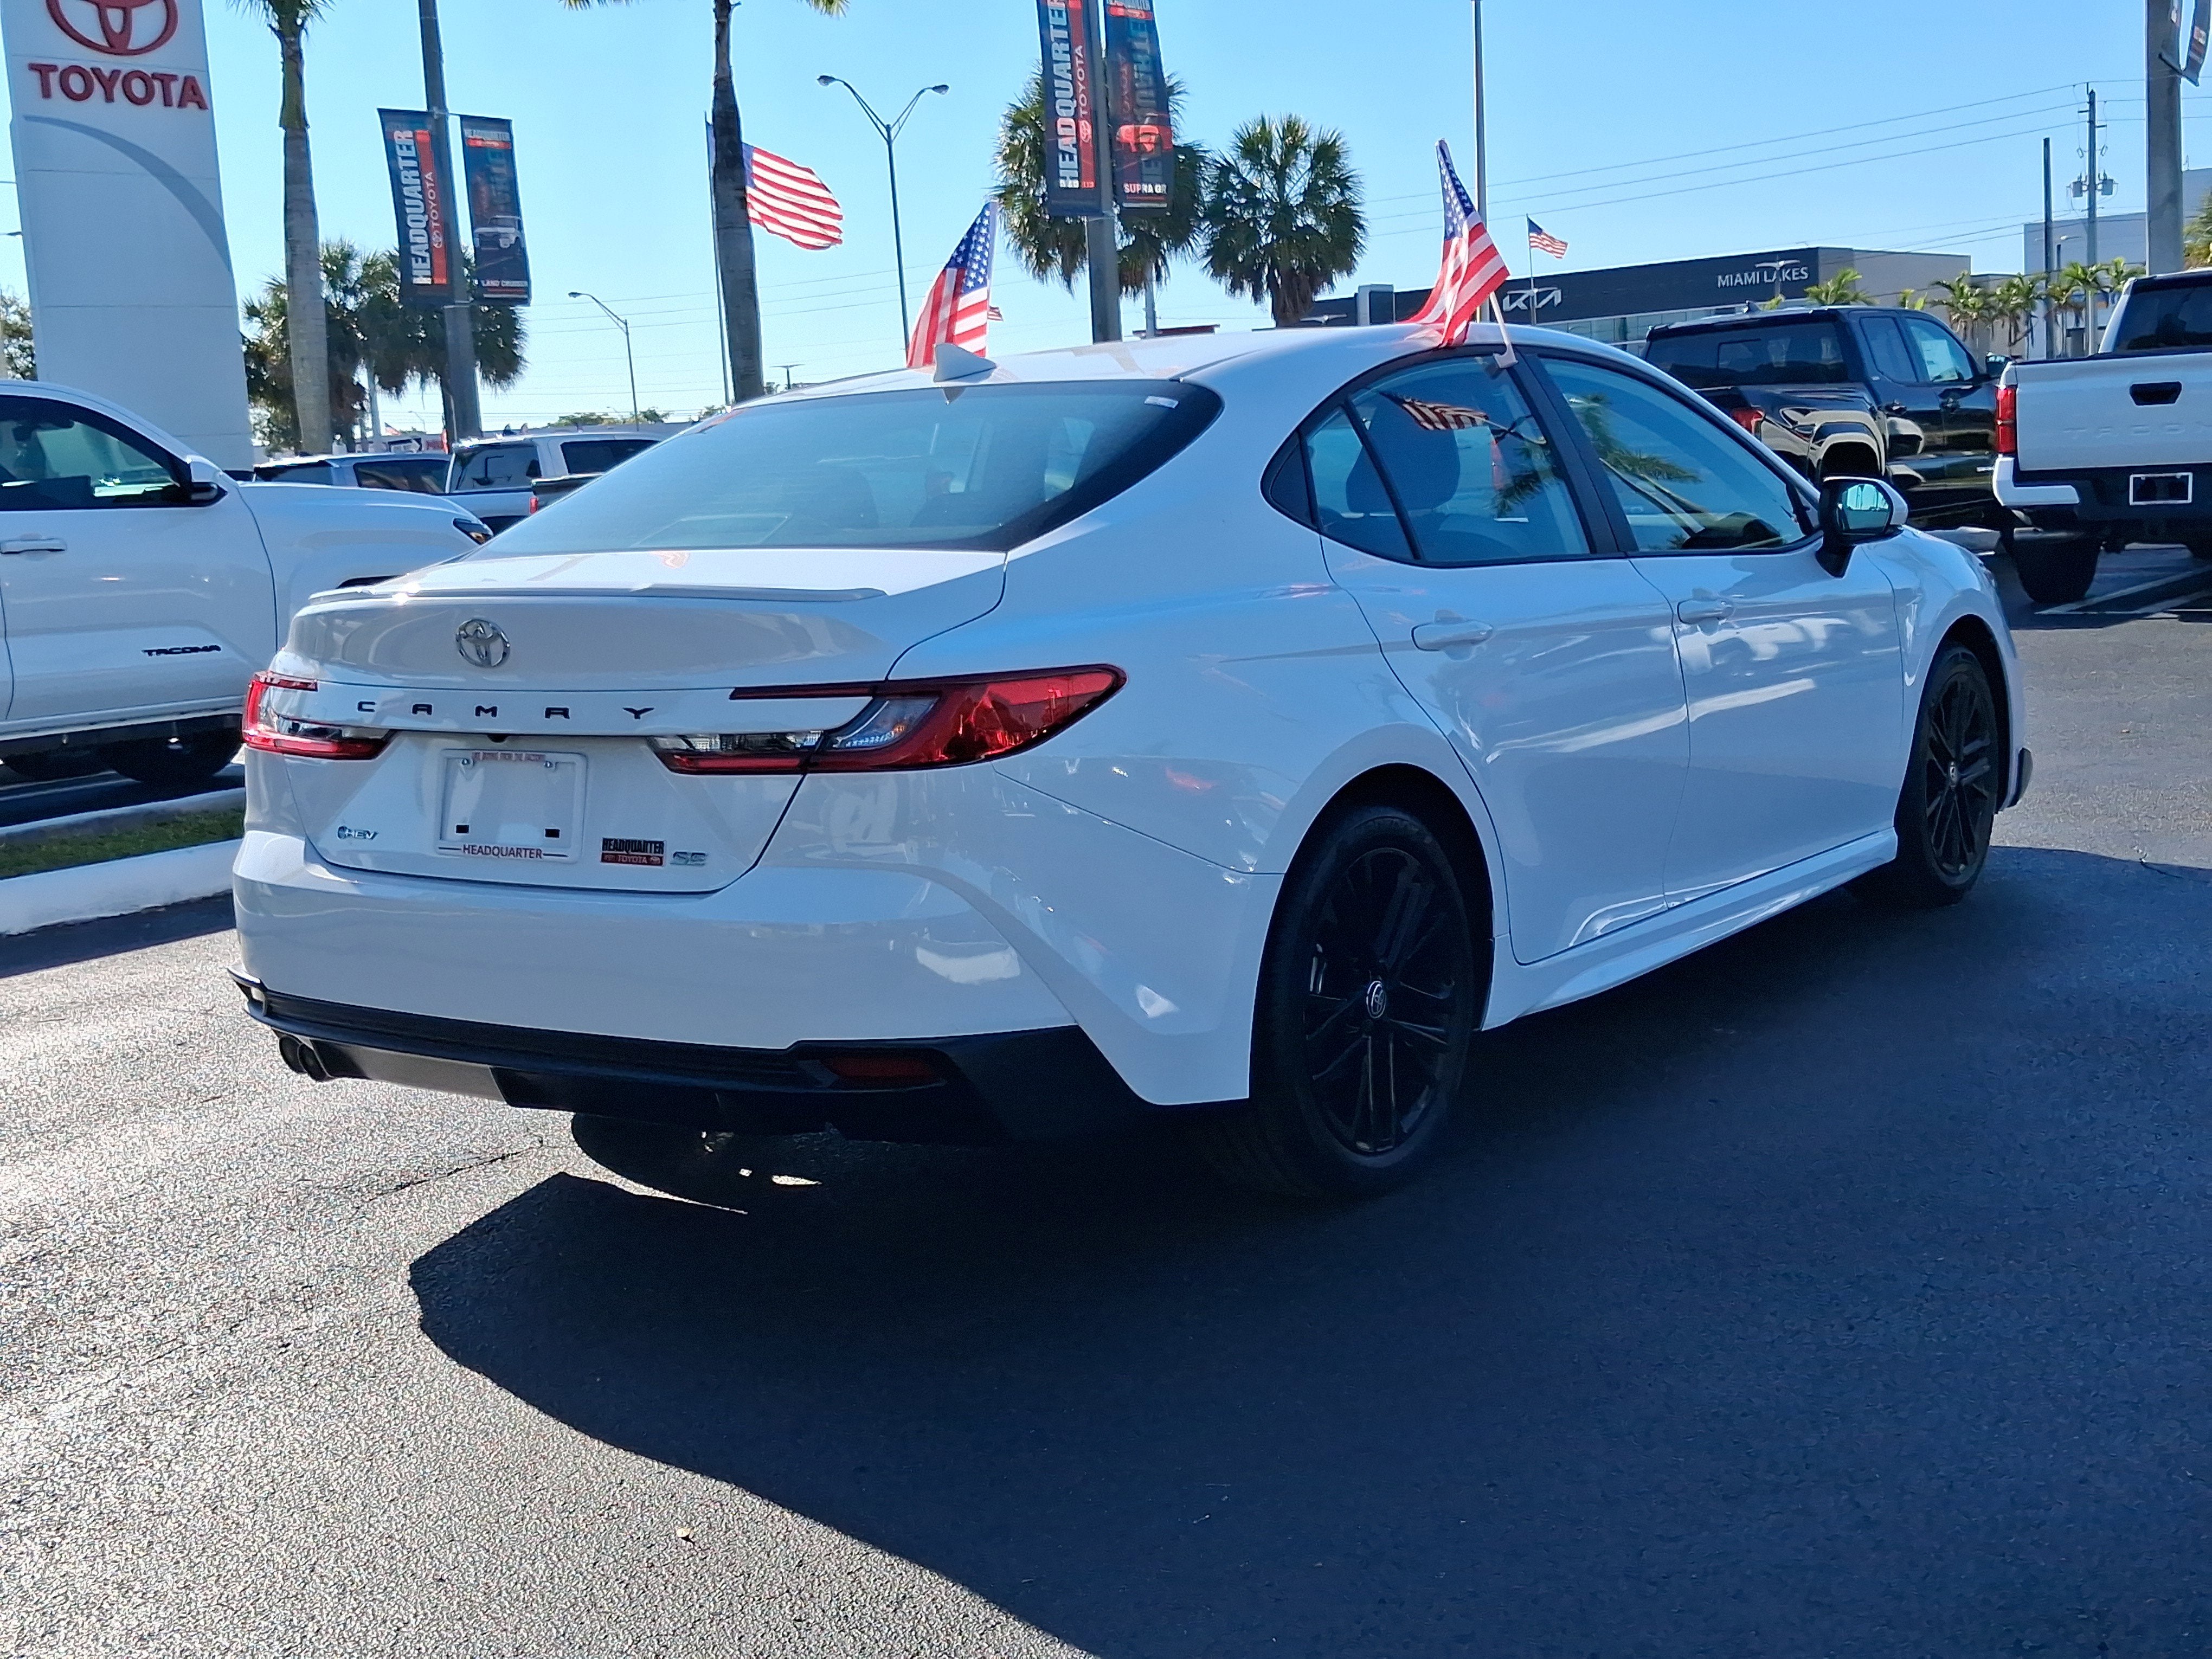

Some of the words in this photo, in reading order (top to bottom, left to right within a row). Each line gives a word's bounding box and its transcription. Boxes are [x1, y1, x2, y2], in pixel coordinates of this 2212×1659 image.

[28, 63, 209, 110] TOYOTA
[1075, 45, 1088, 118] TOYOTA
[394, 130, 432, 285] HEADQUARTER
[425, 172, 440, 228] TOYOTA
[1717, 271, 1760, 288] MIAMI
[1502, 289, 1562, 312] KIA
[142, 645, 222, 657] TACOMA
[357, 700, 655, 720] CAMRY
[463, 844, 543, 859] HEADQUARTER
[602, 838, 665, 855] HEADQUARTER
[618, 854, 648, 864] TOYOTA
